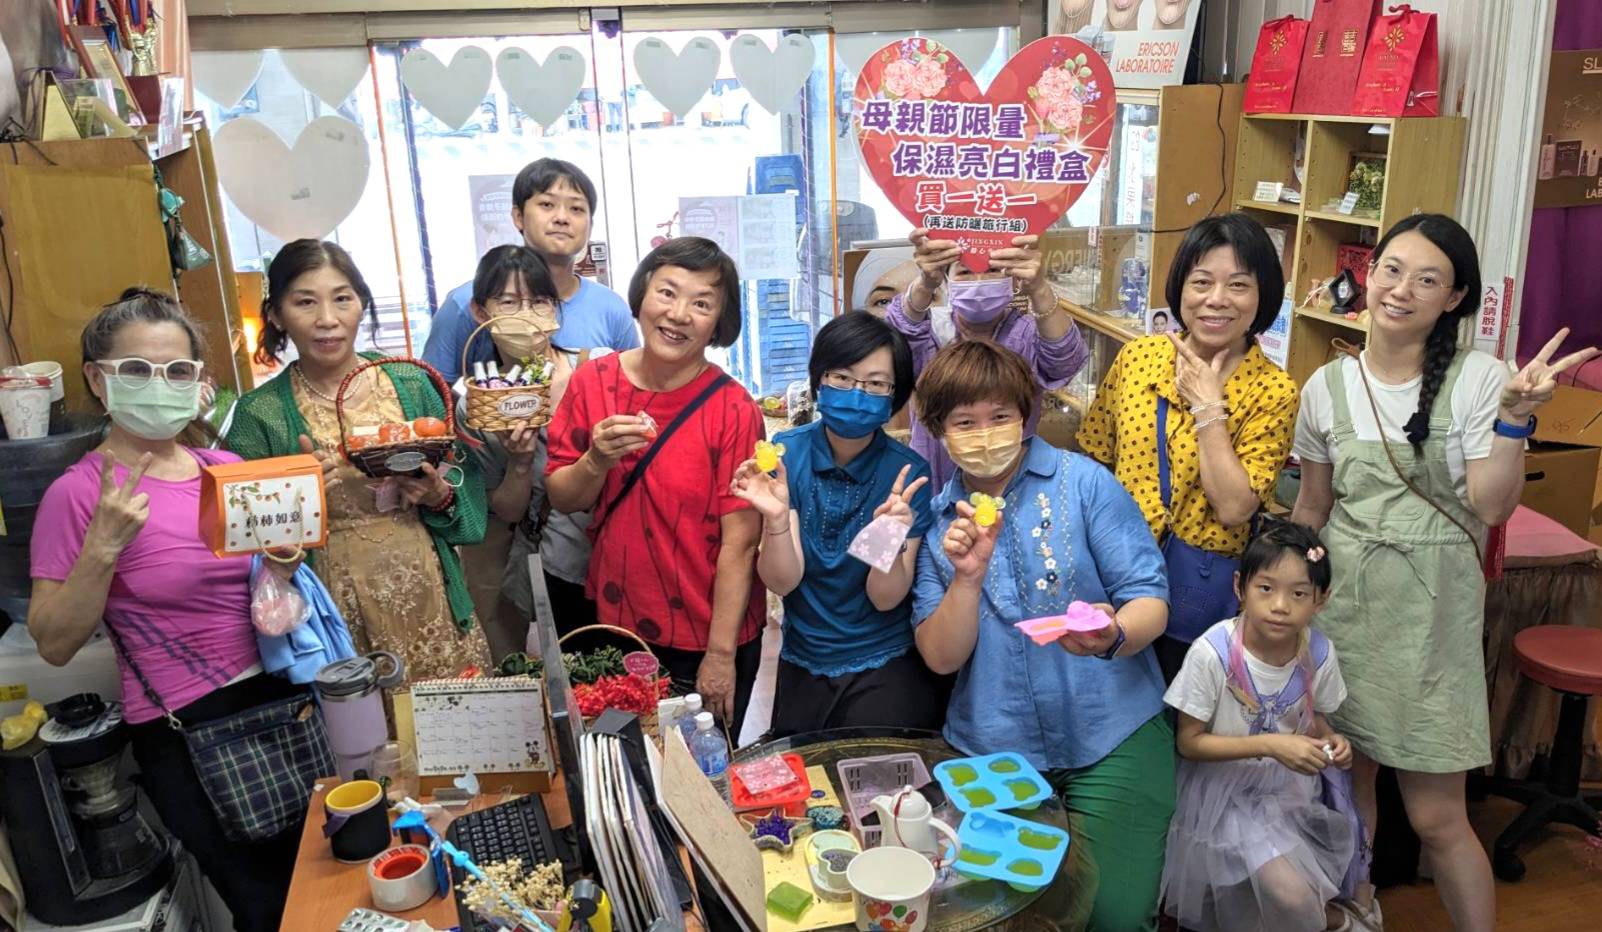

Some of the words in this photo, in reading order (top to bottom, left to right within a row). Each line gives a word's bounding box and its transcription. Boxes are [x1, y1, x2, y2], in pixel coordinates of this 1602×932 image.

[1137, 41, 1180, 57] ERICSON
[1115, 58, 1175, 74] LABORATOIRE
[861, 100, 1027, 139] 母親節限量
[892, 142, 1091, 182] 保濕亮白禮盒
[916, 183, 1037, 215] 買一送一
[1481, 286, 1498, 336] 入內請脫鞋
[504, 400, 537, 411] FLOWER
